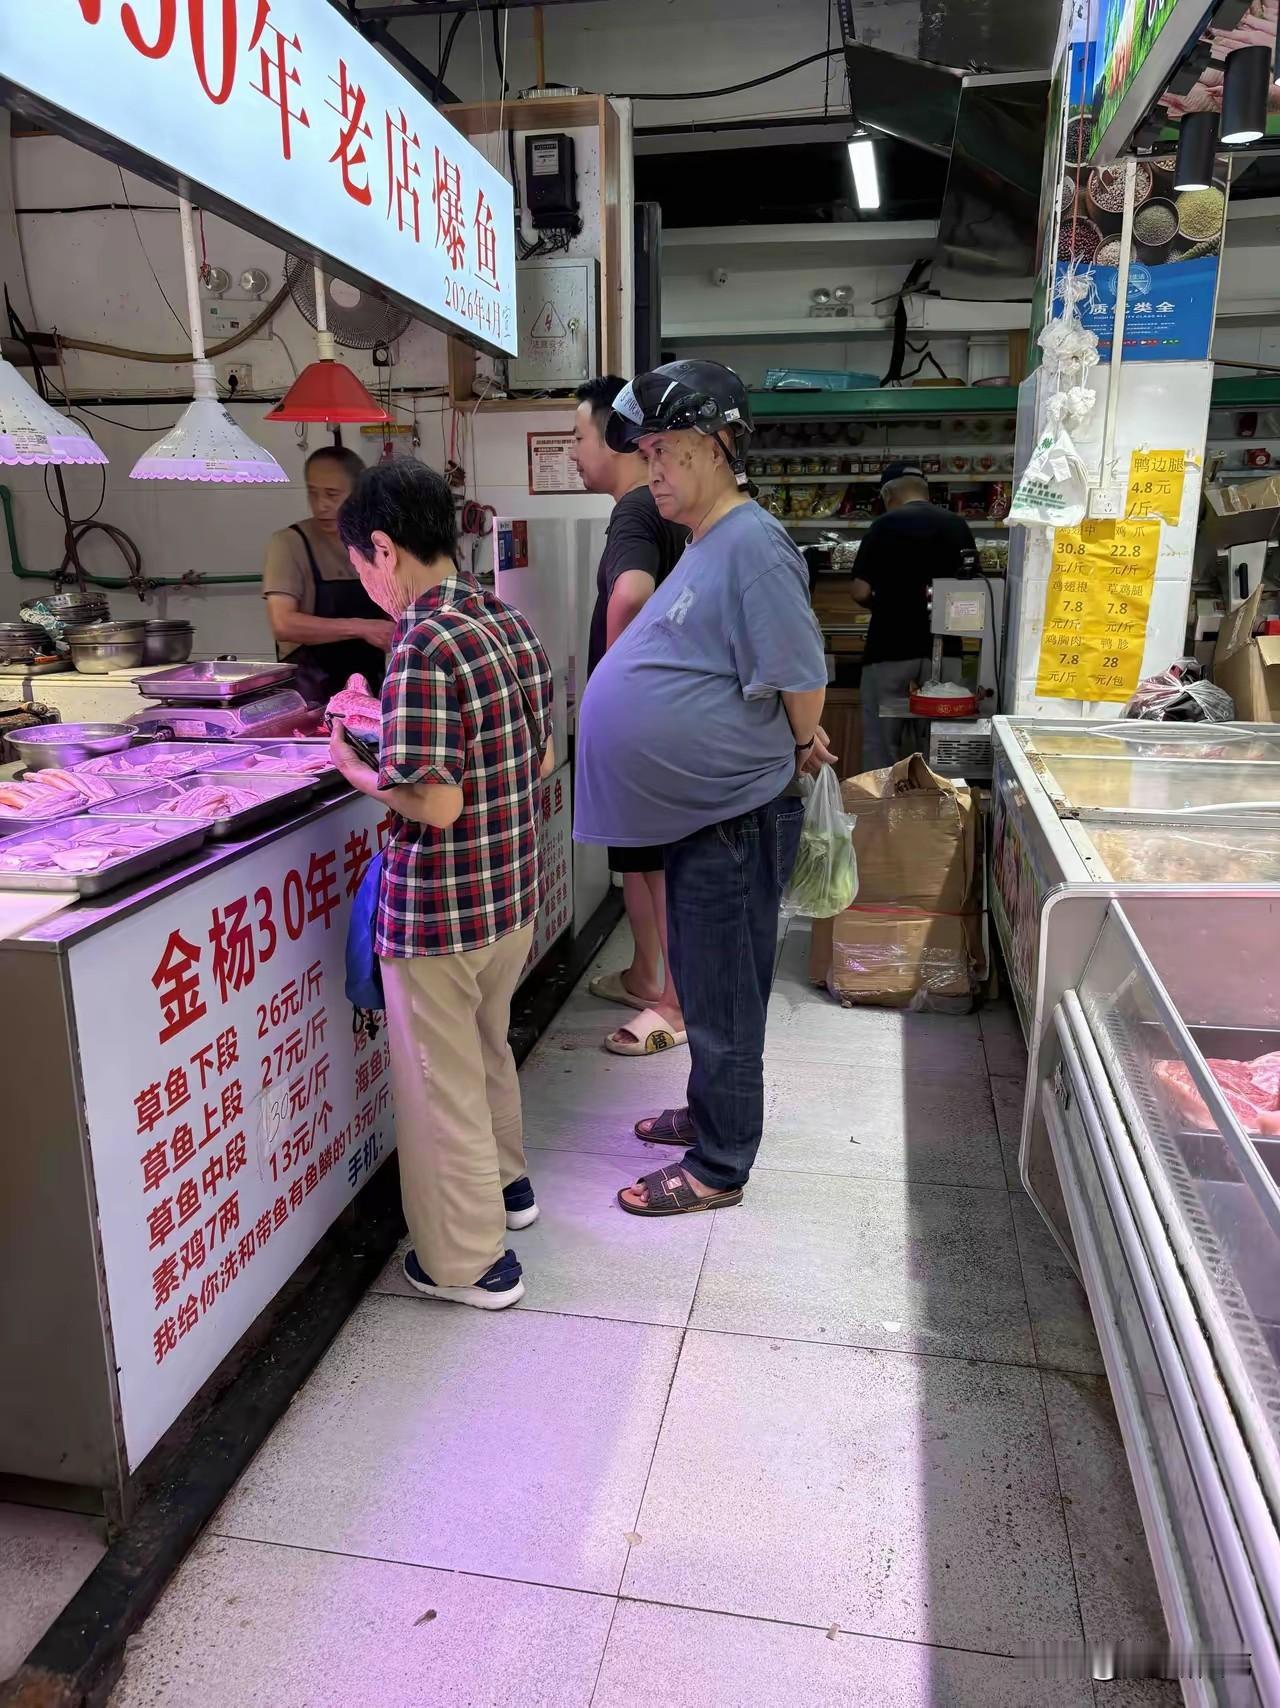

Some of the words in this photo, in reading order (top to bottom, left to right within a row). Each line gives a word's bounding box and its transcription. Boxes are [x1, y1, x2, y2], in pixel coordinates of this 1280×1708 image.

[1134, 457, 1184, 473] 鸭边腿
[1131, 479, 1171, 495] 4.8元
[1057, 543, 1086, 555] 30.8
[1110, 545, 1141, 557] 22.8
[1055, 561, 1085, 574] 元/斤
[1110, 564, 1138, 576] 元/斤
[1052, 581, 1088, 593] 鸡翅根
[1063, 600, 1083, 612] 7.8
[1107, 603, 1128, 614] 7.8
[1050, 618, 1081, 630] 元/斤
[1105, 621, 1134, 633] 元/斤
[1046, 634, 1082, 646] 鸡胸肉
[1059, 653, 1079, 665] 7.8
[1102, 657, 1119, 668] 28
[1048, 671, 1077, 682] 元/斤
[1096, 674, 1124, 687] 元/包
[134, 1025, 240, 1135] 草鱼下段
[256, 960, 325, 1040] 26元/斤
[289, 1052, 331, 1122] 元/斤
[140, 1078, 243, 1194] 草鱼上段
[261, 1006, 328, 1088] 27元/斤
[146, 1129, 248, 1252] 草鱼中段
[151, 1189, 242, 1311] 素鸡7两
[269, 1100, 334, 1183] 13元/个
